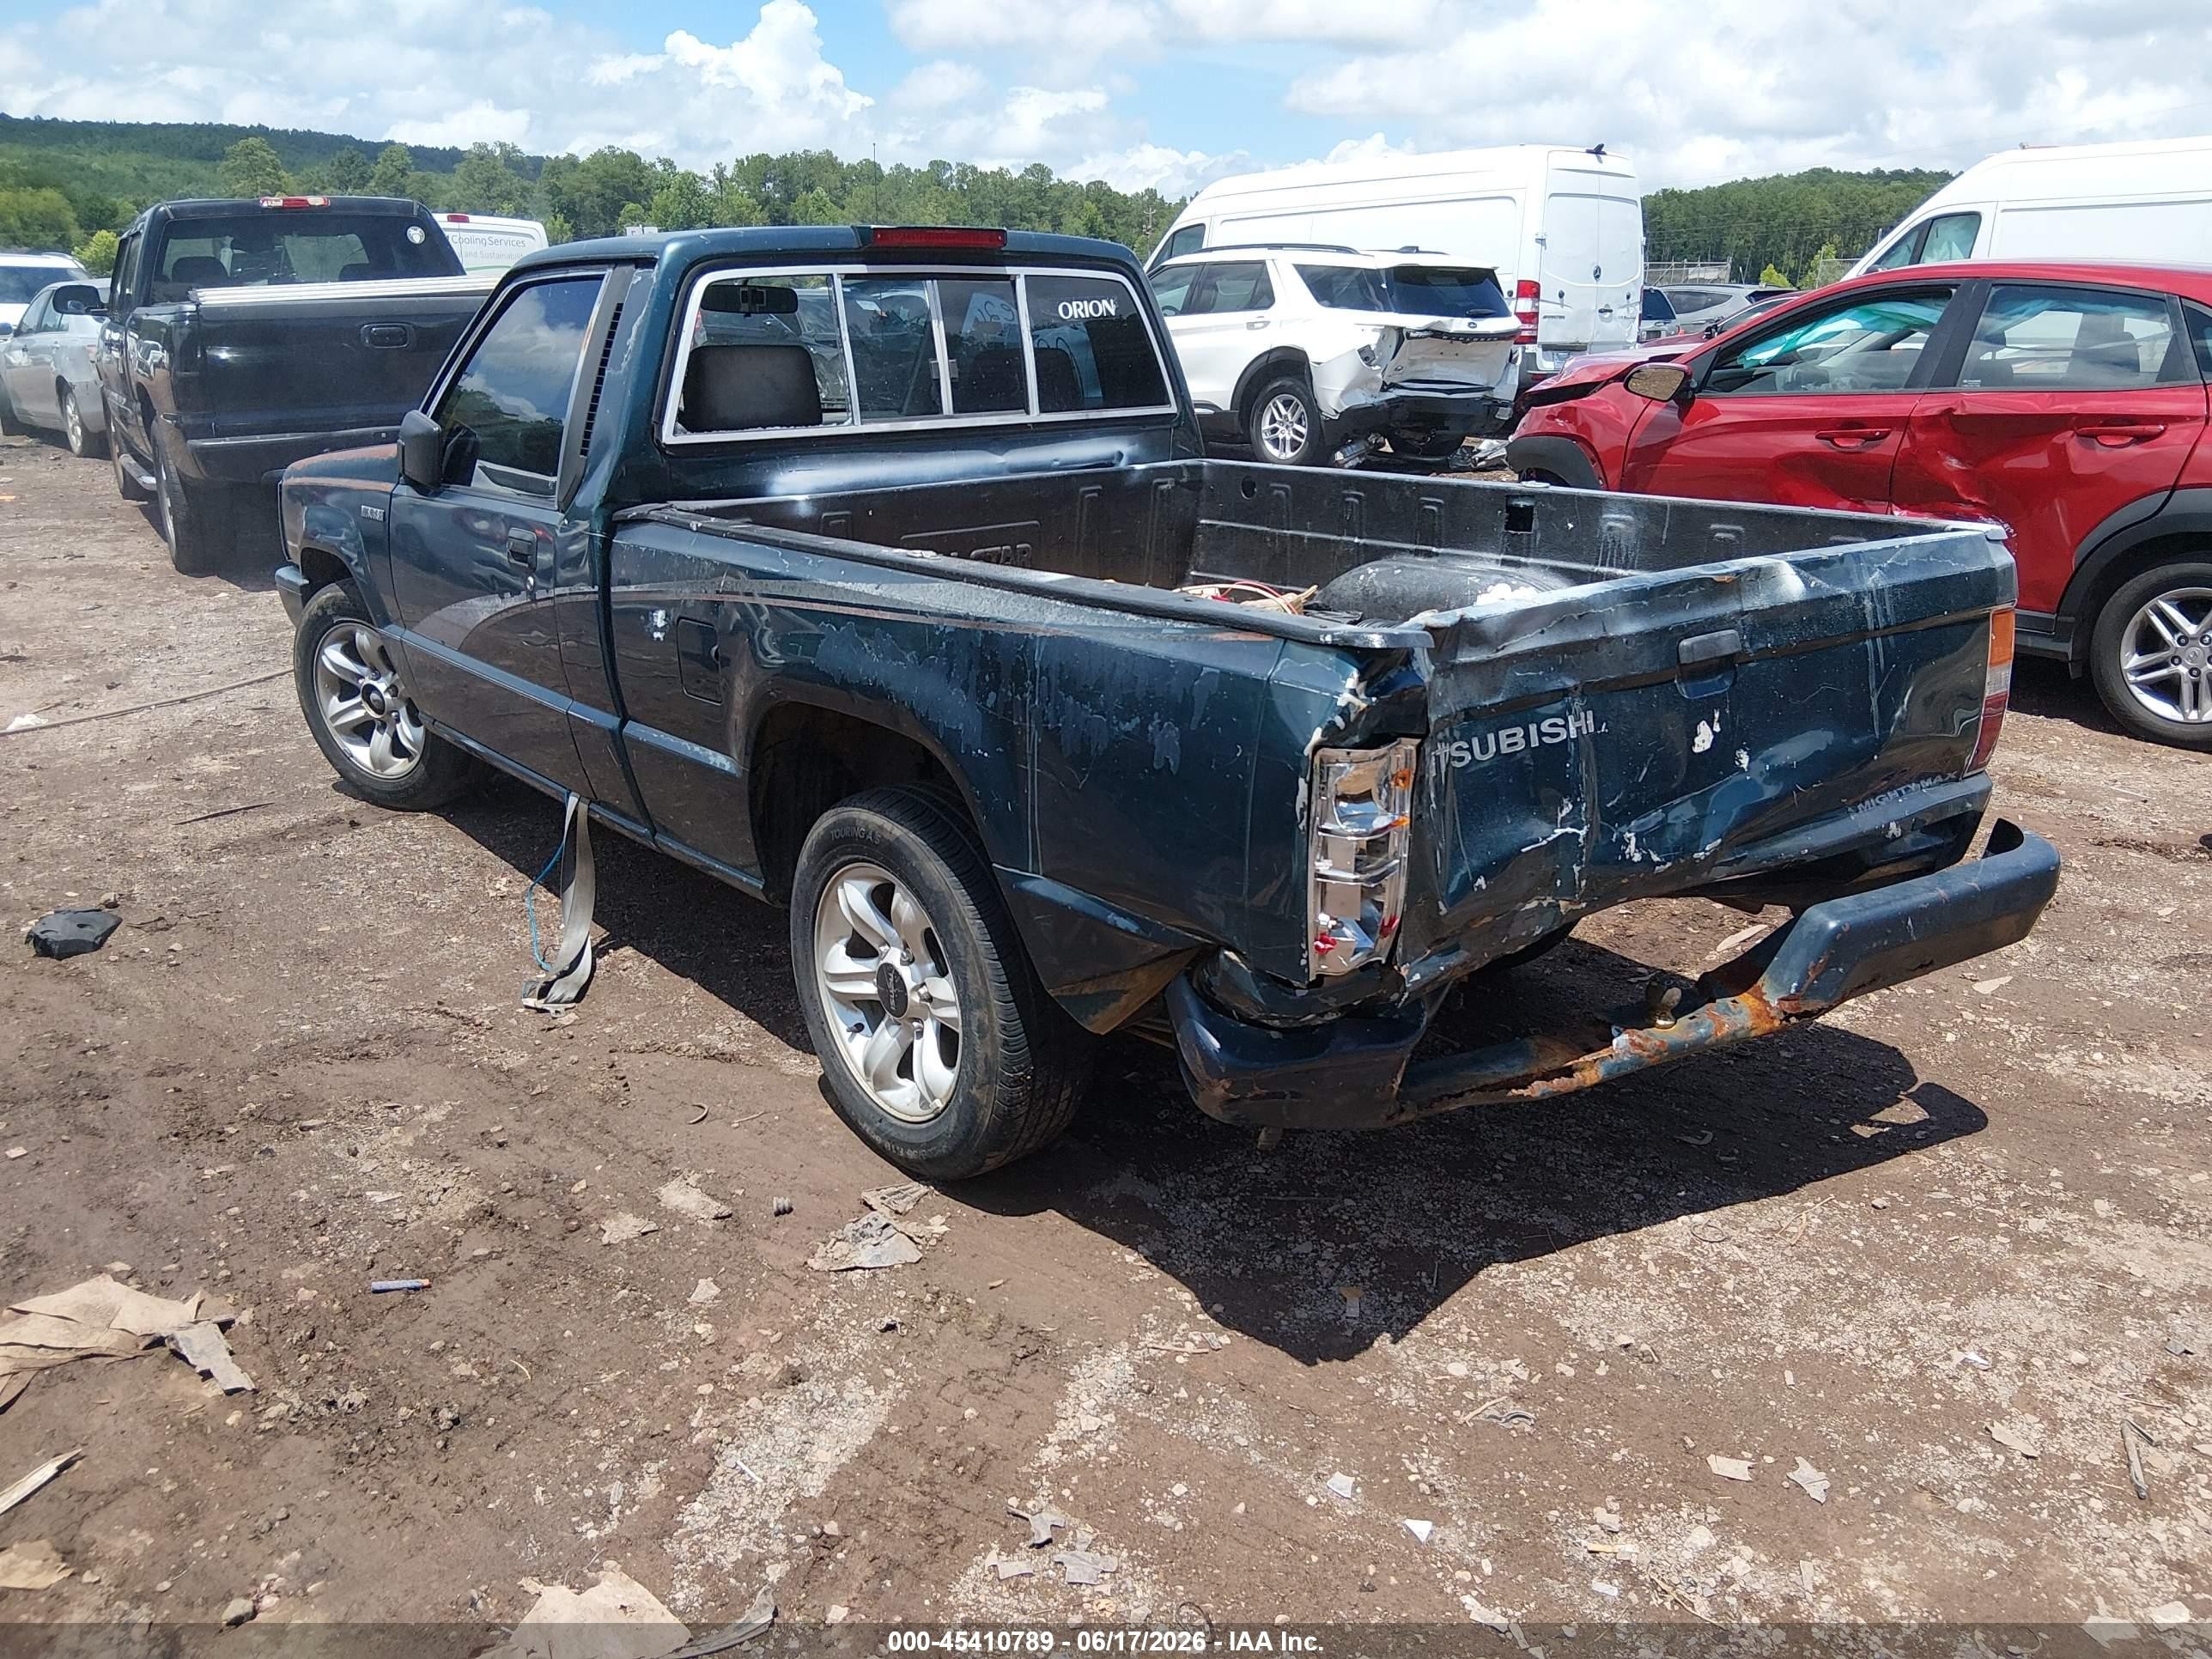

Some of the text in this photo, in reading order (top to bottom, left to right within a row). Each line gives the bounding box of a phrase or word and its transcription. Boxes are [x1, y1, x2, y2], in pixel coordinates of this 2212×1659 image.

[451, 234, 486, 247] Cooling
[488, 236, 526, 247] Services
[1058, 298, 1116, 319] ORION
[1856, 771, 1959, 812] MIGHTY MAX
[830, 826, 866, 842] TOURING
